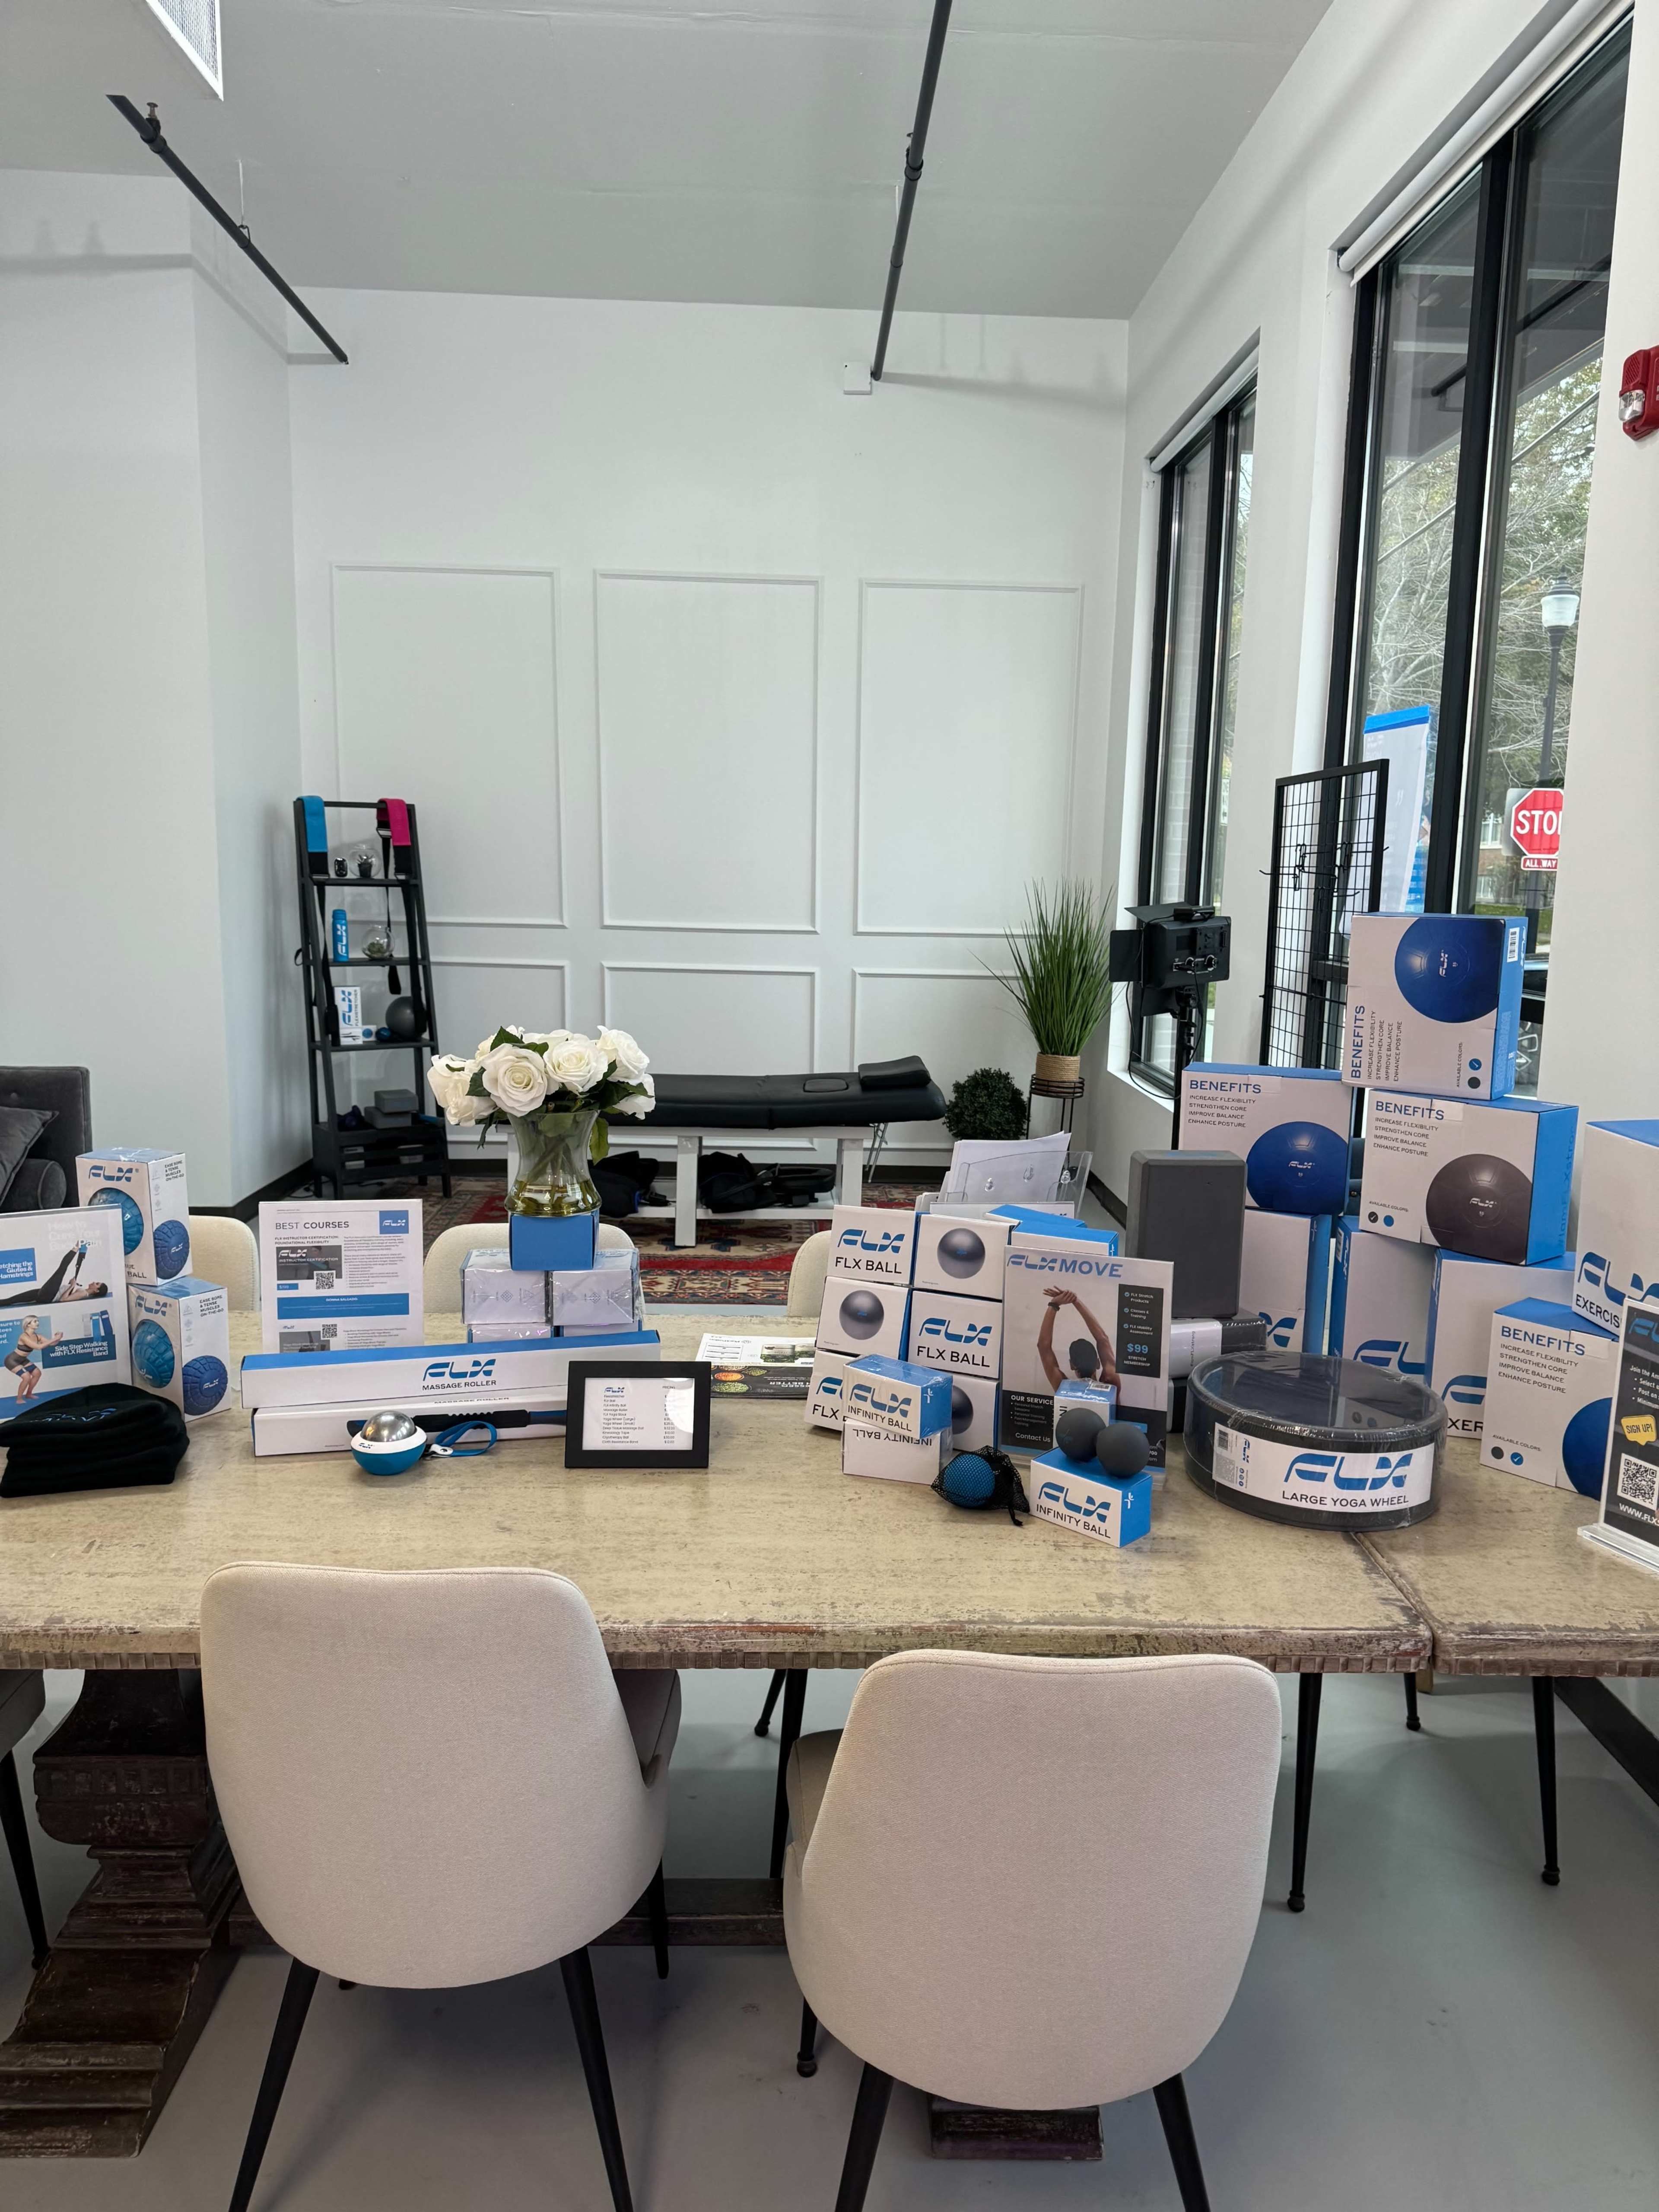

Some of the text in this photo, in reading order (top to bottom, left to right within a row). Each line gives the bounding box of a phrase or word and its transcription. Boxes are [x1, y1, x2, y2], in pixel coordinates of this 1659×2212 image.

[1516, 810, 1563, 835] STO
[1525, 859, 1556, 868] ALL WAY
[337, 924, 347, 956] FLX
[1439, 952, 1448, 977] FLX
[341, 990, 353, 1026] FLX
[1351, 1005, 1365, 1079] BENEFITS
[1190, 1080, 1262, 1094] BENEFITS
[1376, 1100, 1445, 1121] BENEFITS
[1375, 1117, 1439, 1131] INCREASE FLEXIBILITY
[1375, 1126, 1413, 1136] STRENGTHEN
[1374, 1134, 1427, 1147] IMPROVE BALANCE
[1373, 1143, 1429, 1157] ENHANCE POSTURE
[89, 1165, 133, 1182] FLX
[1369, 1200, 1390, 1209] AVAILABLE
[1469, 1197, 1494, 1208] FLX
[79, 1239, 102, 1248] Pain
[171, 1243, 183, 1253] FLX
[837, 1229, 905, 1254] FLX
[279, 1249, 307, 1257] FLX
[835, 1257, 902, 1274] FLX BALL
[135, 1295, 168, 1316] FLX
[200, 1308, 224, 1317] ON-THE-GO
[1576, 1294, 1622, 1328] EXERCIS
[918, 1318, 992, 1346] FLX
[1127, 1343, 1148, 1354] $99
[1501, 1326, 1586, 1356] BENEFITS
[76, 1346, 108, 1354] Resistance
[917, 1346, 990, 1368] FLX BALL
[1500, 1344, 1579, 1367] INCREASE FLEXIBILITY
[423, 1359, 496, 1381] FLX
[1499, 1362, 1564, 1383] IMPROVE BALANCE
[1500, 1353, 1568, 1375] STRENGTHEN CORE
[203, 1378, 219, 1389] FLX
[423, 1382, 462, 1391] MASSAGE
[1498, 1372, 1566, 1394] ENHANCE POSTURE
[1638, 1387, 1649, 1396] Post
[1640, 1378, 1655, 1388] Select
[849, 1384, 912, 1418] FLX
[813, 1404, 839, 1420] FLX
[848, 1405, 912, 1432] INFINITY BALL
[1626, 1423, 1653, 1434] SIGN UP!
[852, 1429, 932, 1446] INFINITY BALL
[1493, 1435, 1519, 1445] AVAILABLE
[1242, 1438, 1250, 1464] FLX
[1284, 1453, 1413, 1491] FLX
[1039, 1482, 1111, 1523] FLX
[1282, 1490, 1409, 1507] LARGE YOGA WHEEL
[1036, 1504, 1111, 1539] INFINITY BALL
[1619, 1503, 1659, 1526] WWW.FLX
